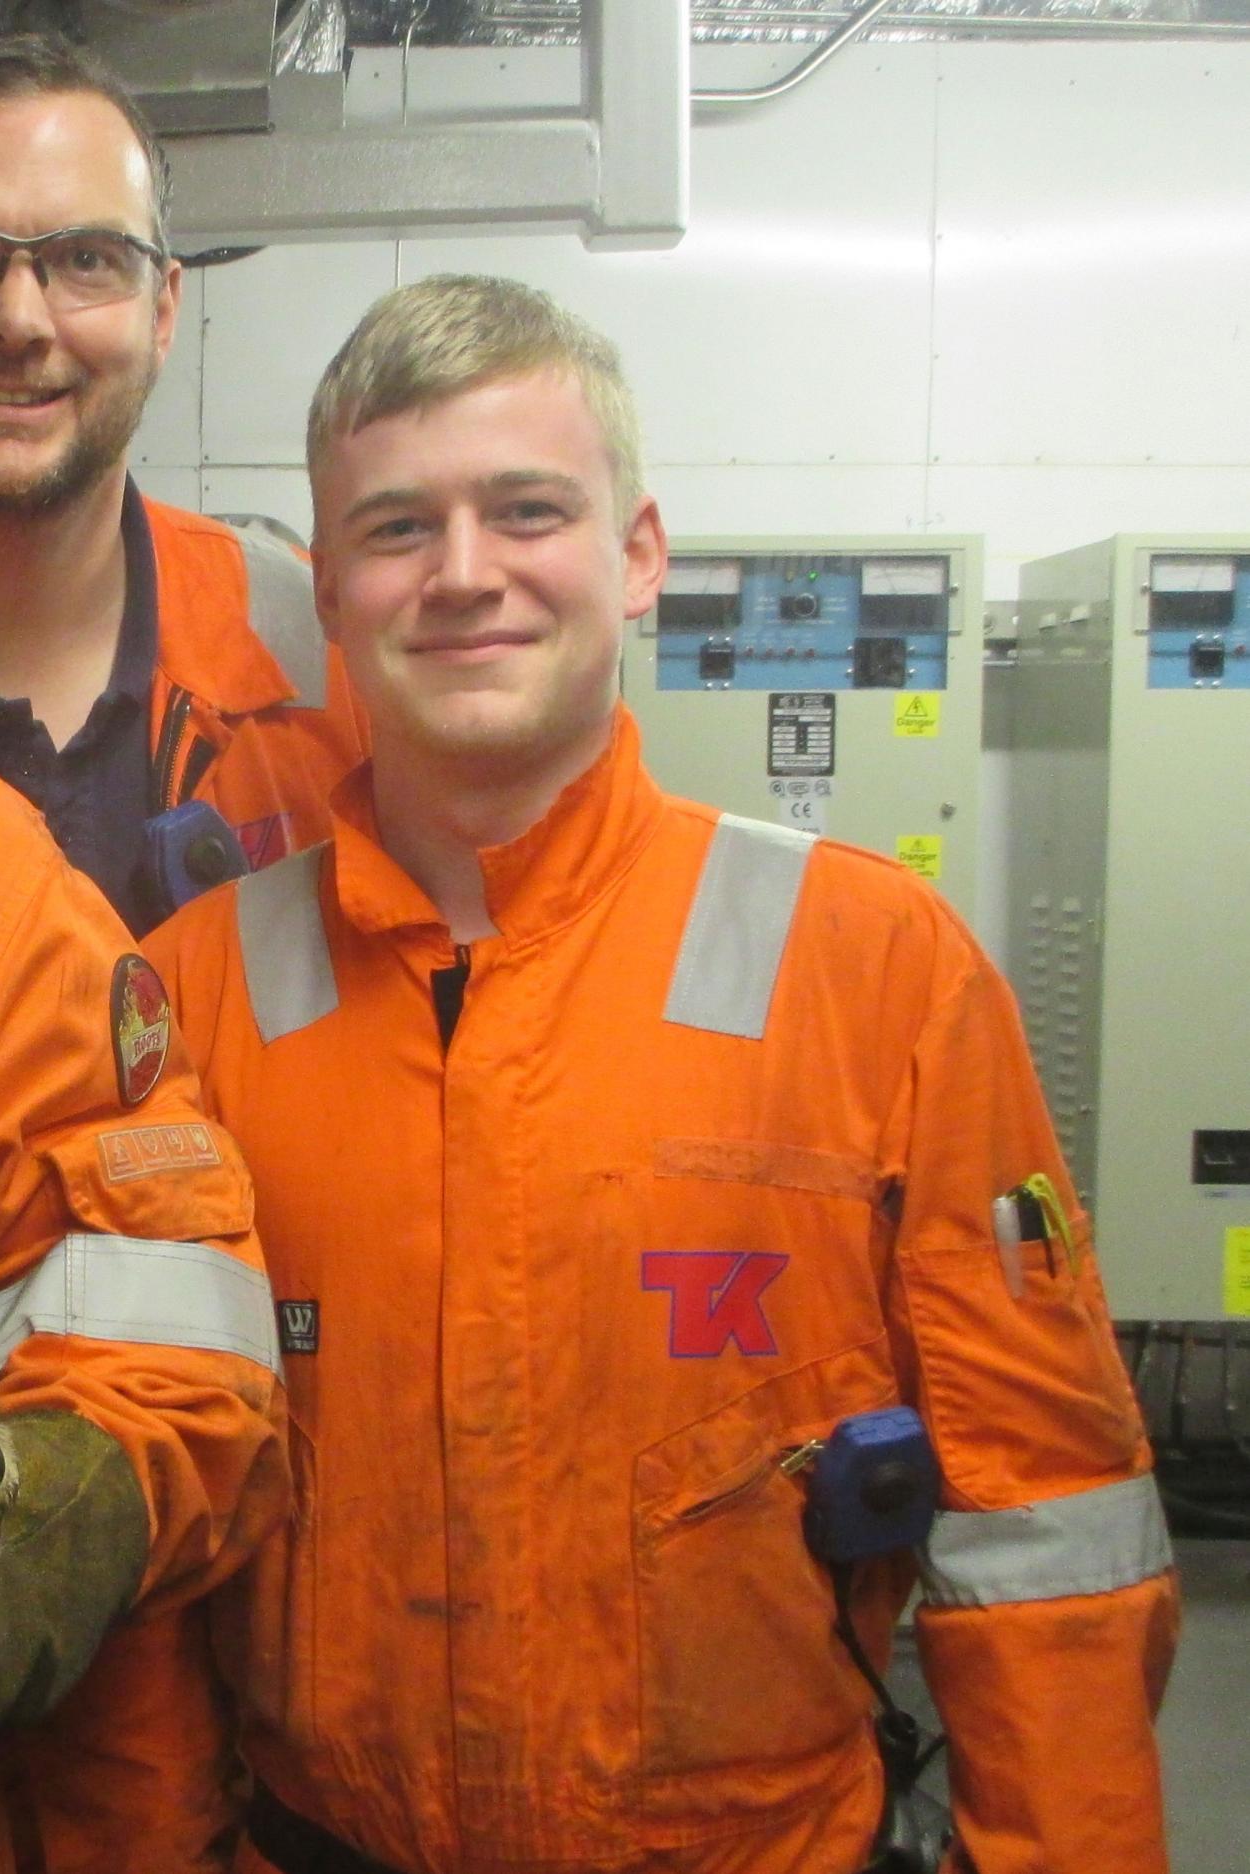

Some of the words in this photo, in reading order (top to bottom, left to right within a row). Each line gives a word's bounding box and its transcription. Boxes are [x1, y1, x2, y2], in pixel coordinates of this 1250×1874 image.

[897, 717, 936, 727] Danger
[791, 802, 812, 818] CE
[641, 1250, 790, 1358] TK
